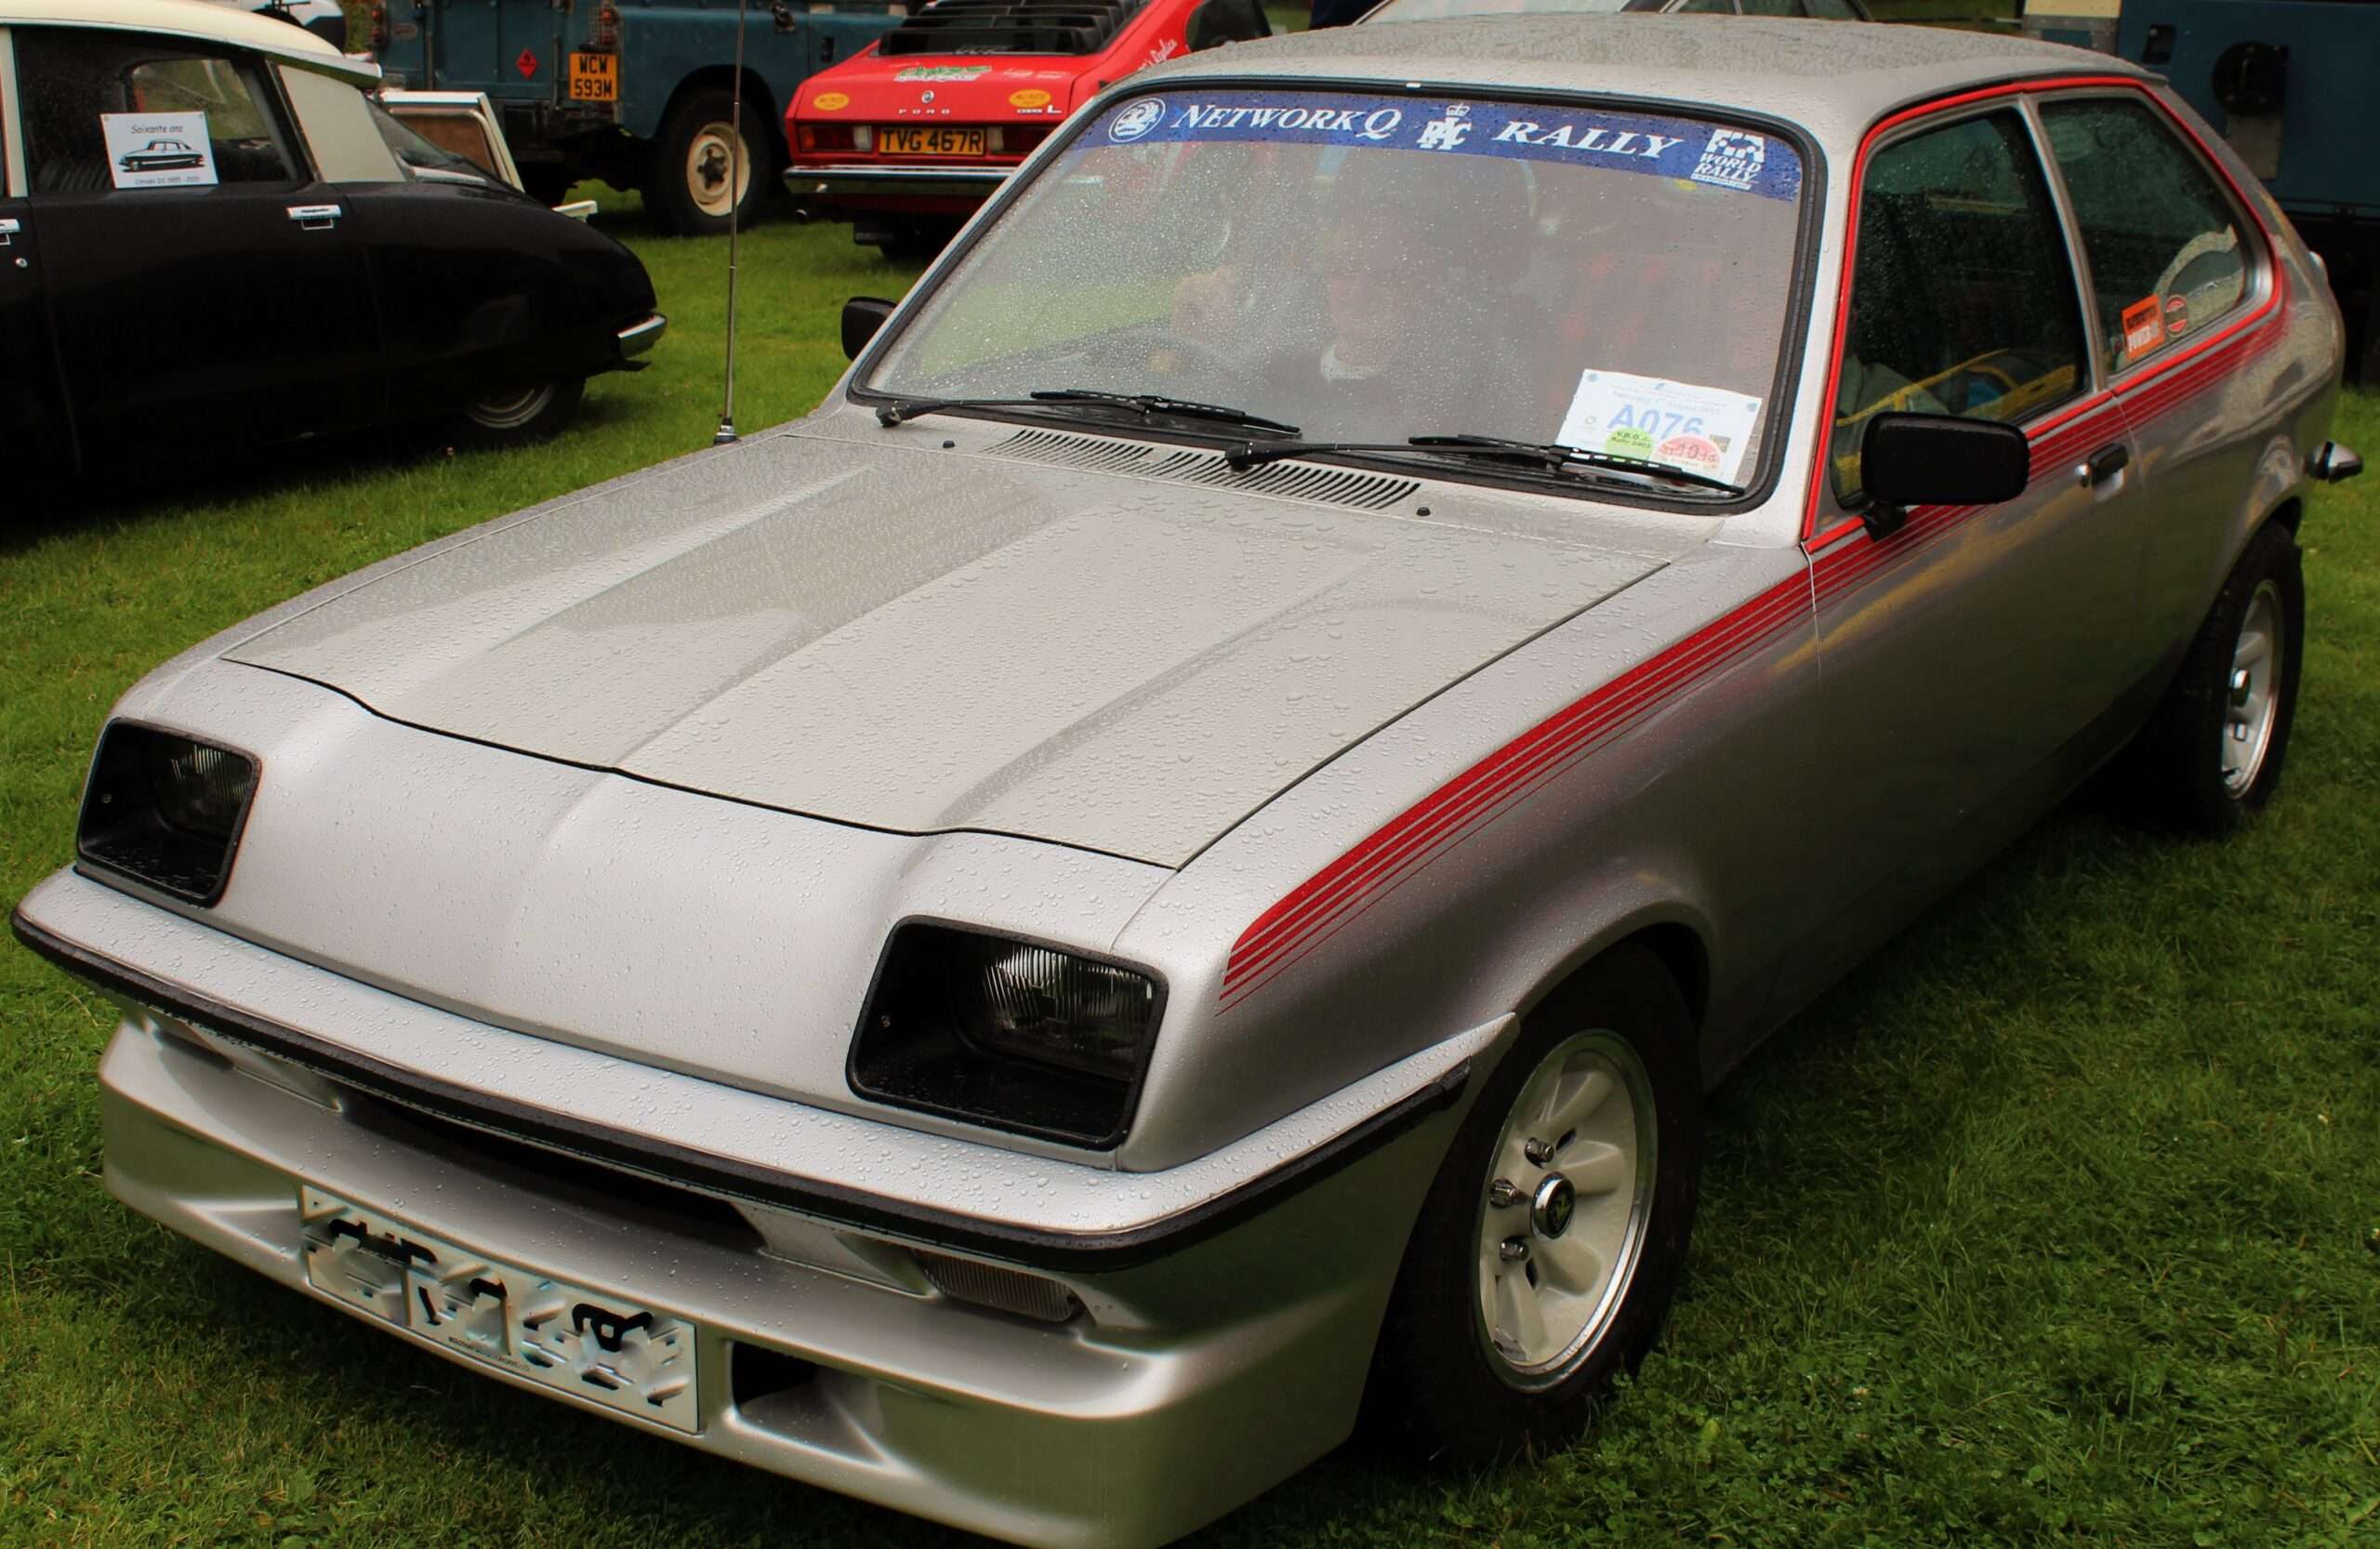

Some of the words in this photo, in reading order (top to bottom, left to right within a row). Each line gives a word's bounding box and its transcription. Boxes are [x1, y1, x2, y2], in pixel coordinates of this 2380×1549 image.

[579, 56, 608, 73] WCW
[575, 78, 612, 98] 593M
[131, 125, 166, 135] Soixante
[169, 125, 184, 133] ans
[1492, 121, 1685, 158] RALLY
[882, 129, 923, 150] TVG
[926, 130, 982, 152] 467R
[1699, 152, 1762, 173] WORLD
[1694, 163, 1758, 183] RALLY
[1606, 404, 1704, 441] A076
